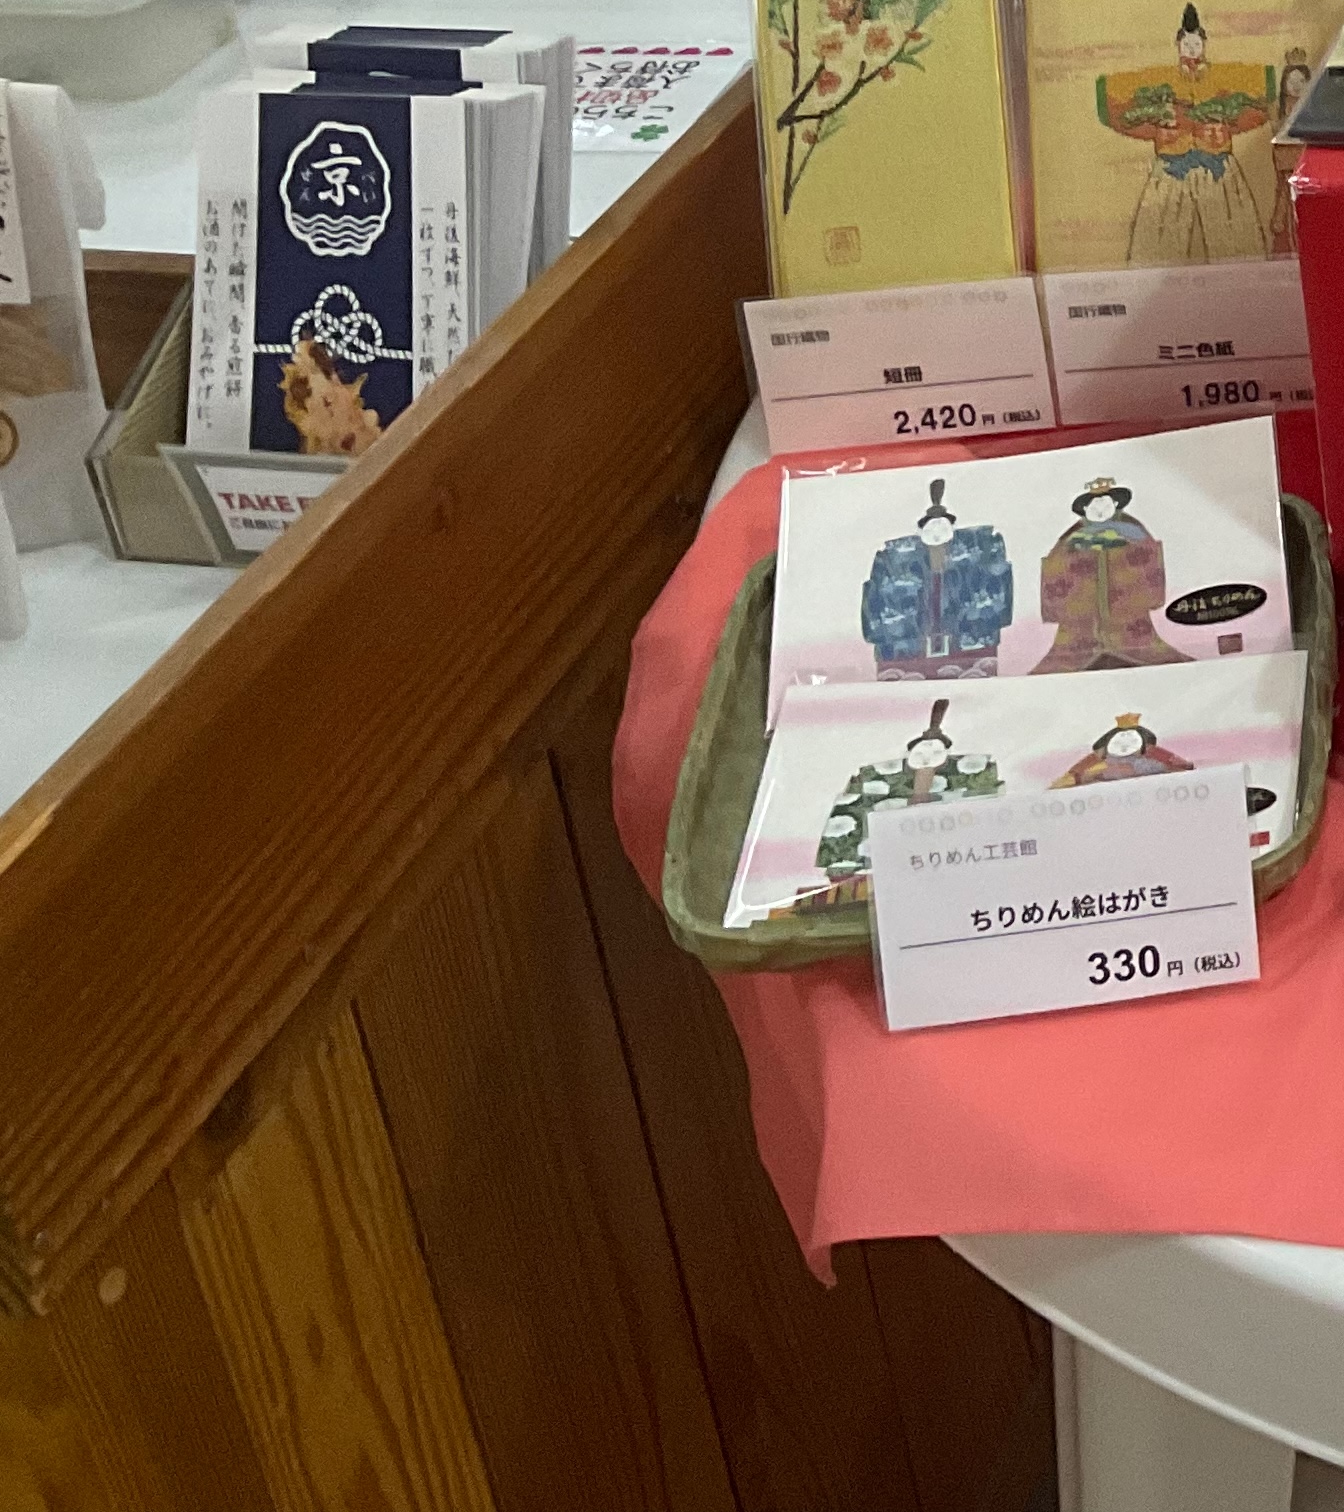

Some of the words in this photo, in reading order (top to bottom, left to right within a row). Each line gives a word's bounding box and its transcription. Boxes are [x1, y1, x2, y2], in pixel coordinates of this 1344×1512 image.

[310, 143, 363, 207] 京
[882, 365, 923, 385] 短冊
[1181, 381, 1260, 409] 1,980
[893, 404, 977, 436] 2,420
[217, 491, 297, 513] TAKE
[971, 885, 1171, 932] ちりめん絵はがき
[1086, 944, 1161, 986] 330
